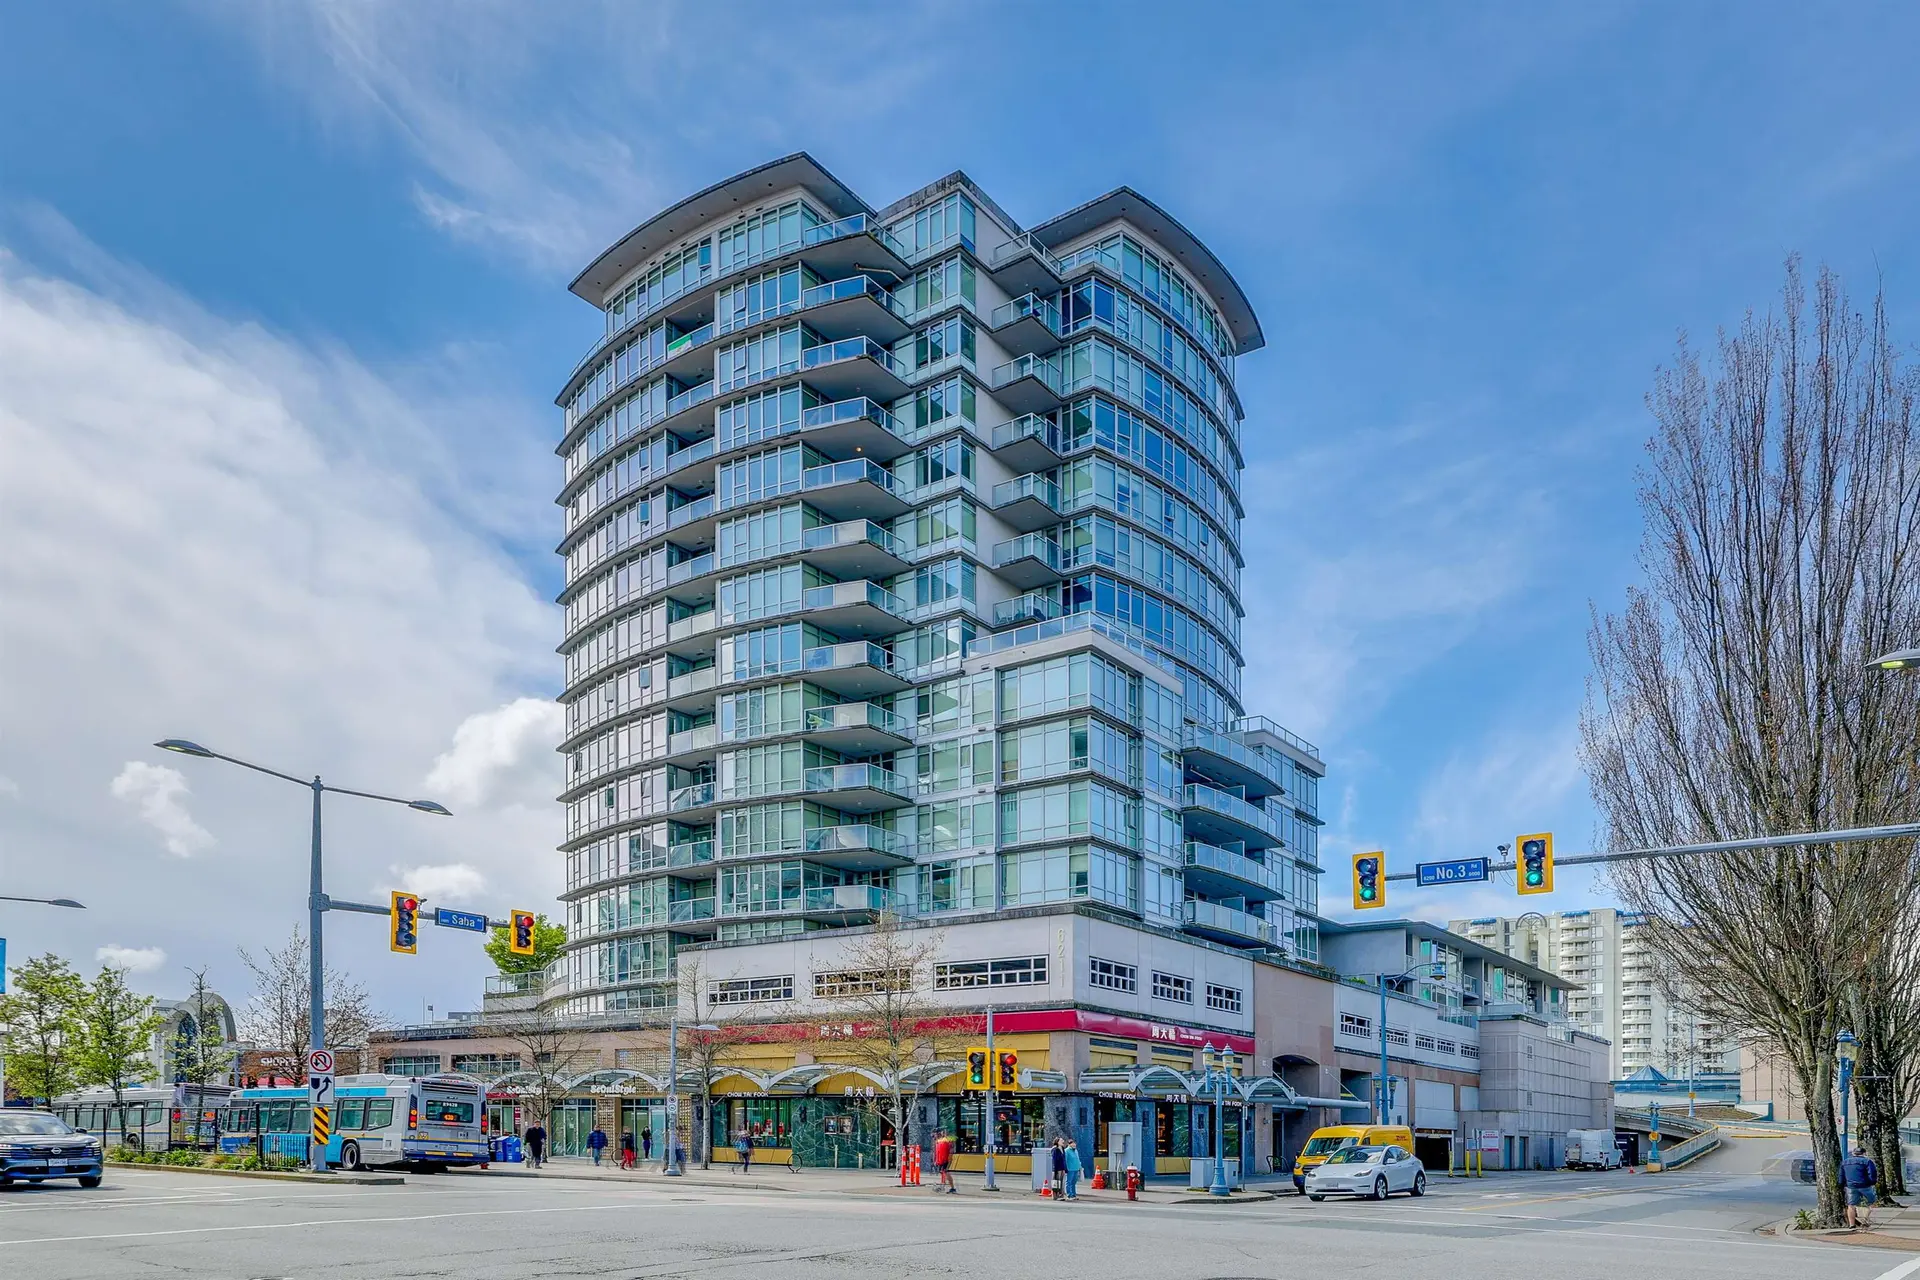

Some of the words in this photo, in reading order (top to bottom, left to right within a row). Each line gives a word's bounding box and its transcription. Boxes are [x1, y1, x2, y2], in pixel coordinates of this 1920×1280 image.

[452, 914, 475, 927] Saba
[1151, 1025, 1176, 1041] 周大福
[844, 1085, 875, 1097] 周大福
[1098, 1091, 1113, 1099] CHOW
[1165, 1094, 1187, 1104] 周大福
